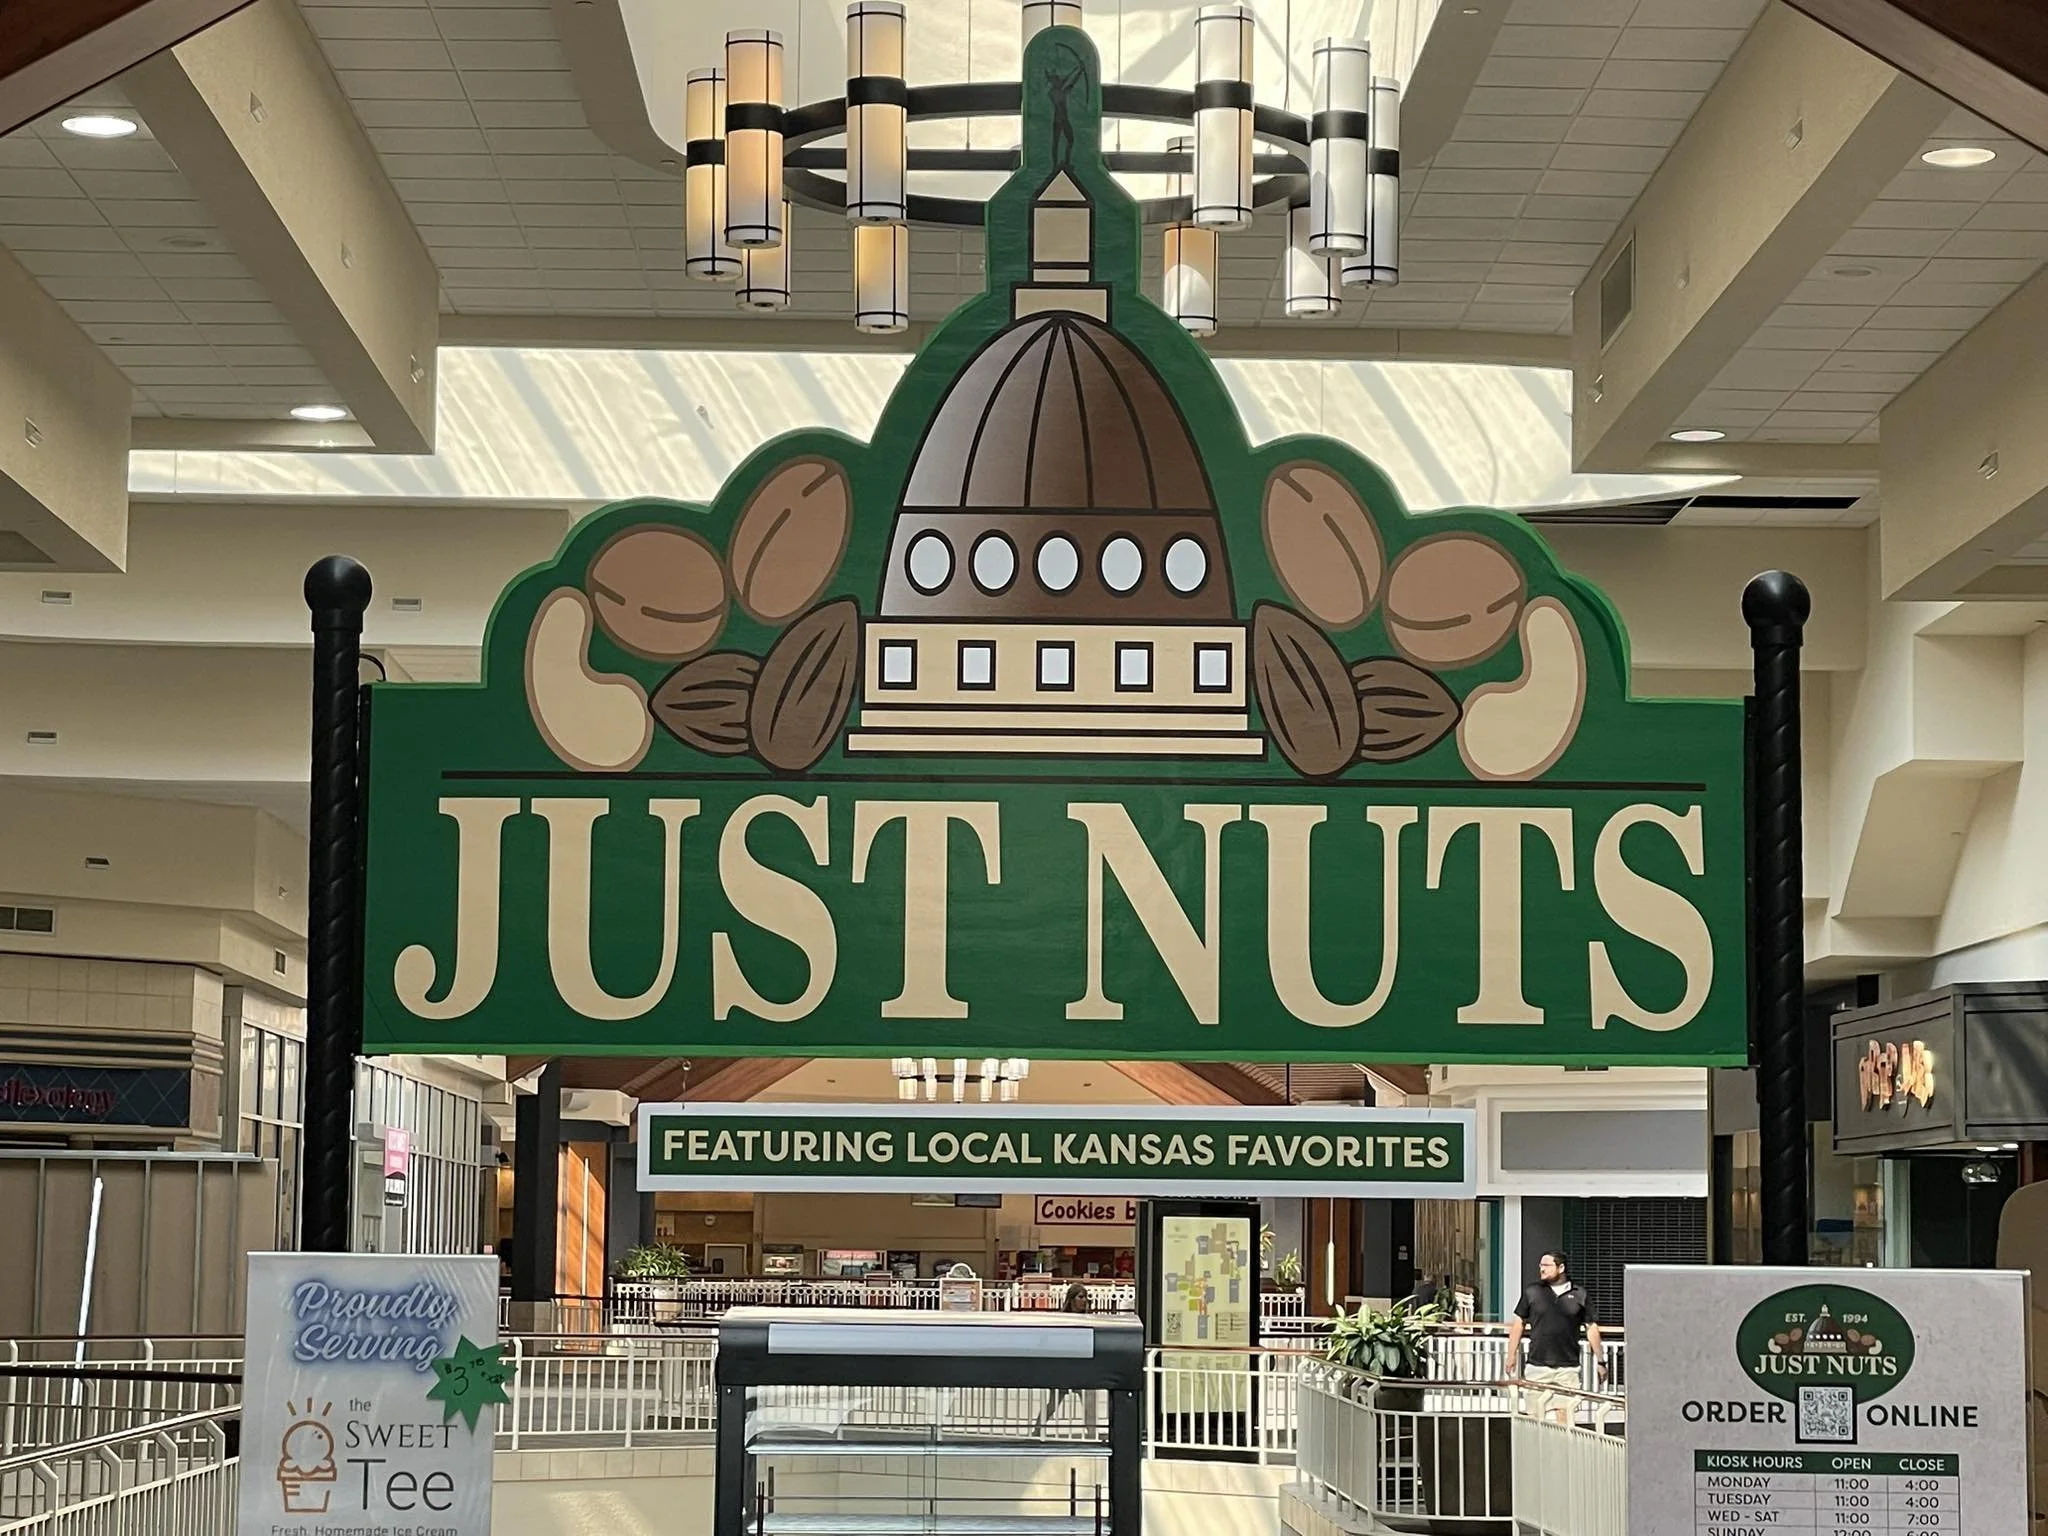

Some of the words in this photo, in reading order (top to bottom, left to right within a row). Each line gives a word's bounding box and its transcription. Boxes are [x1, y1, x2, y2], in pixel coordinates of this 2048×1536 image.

[394, 794, 1001, 1023] JUST
[1065, 803, 1714, 1032] NUTS
[663, 1129, 894, 1163] FEATURING
[907, 1131, 1042, 1164] LOCAL
[1053, 1133, 1214, 1166] KANSAS
[1228, 1134, 1451, 1168] FAVORITES
[1041, 1199, 1116, 1220] Cookies
[295, 1280, 458, 1331] Proudly
[1784, 1312, 1807, 1323] EST.
[1842, 1313, 1868, 1324] 1994
[294, 1323, 446, 1373] Serving
[1754, 1353, 1820, 1375] JUST
[1826, 1354, 1897, 1376] NUTS
[349, 1397, 372, 1412] the
[1681, 1400, 1786, 1424] ORDER
[1866, 1404, 1978, 1428] ONLINE
[345, 1420, 458, 1449] SWEET
[1707, 1455, 1749, 1468] KIOSK
[1753, 1456, 1803, 1469] HOURS
[1831, 1457, 1871, 1470] OPEN
[1899, 1458, 1945, 1471] CLOSE
[346, 1458, 455, 1511] Tee
[1707, 1476, 1771, 1488] MONDAY
[1834, 1478, 1870, 1490] 11:00
[1905, 1479, 1939, 1491] 4:00
[1707, 1493, 1772, 1505] TUESDAY
[1834, 1495, 1870, 1507] 11:00
[1905, 1497, 1939, 1508] 4:00
[1707, 1510, 1741, 1522] WED
[1754, 1511, 1780, 1523] SAT
[1835, 1512, 1870, 1524] 11:00
[1907, 1514, 1940, 1525] 7:00
[314, 1525, 391, 1536] Homemade
[393, 1526, 413, 1536] Ice
[416, 1526, 458, 1536] Cream
[1707, 1527, 1766, 1536] SUNDAY
